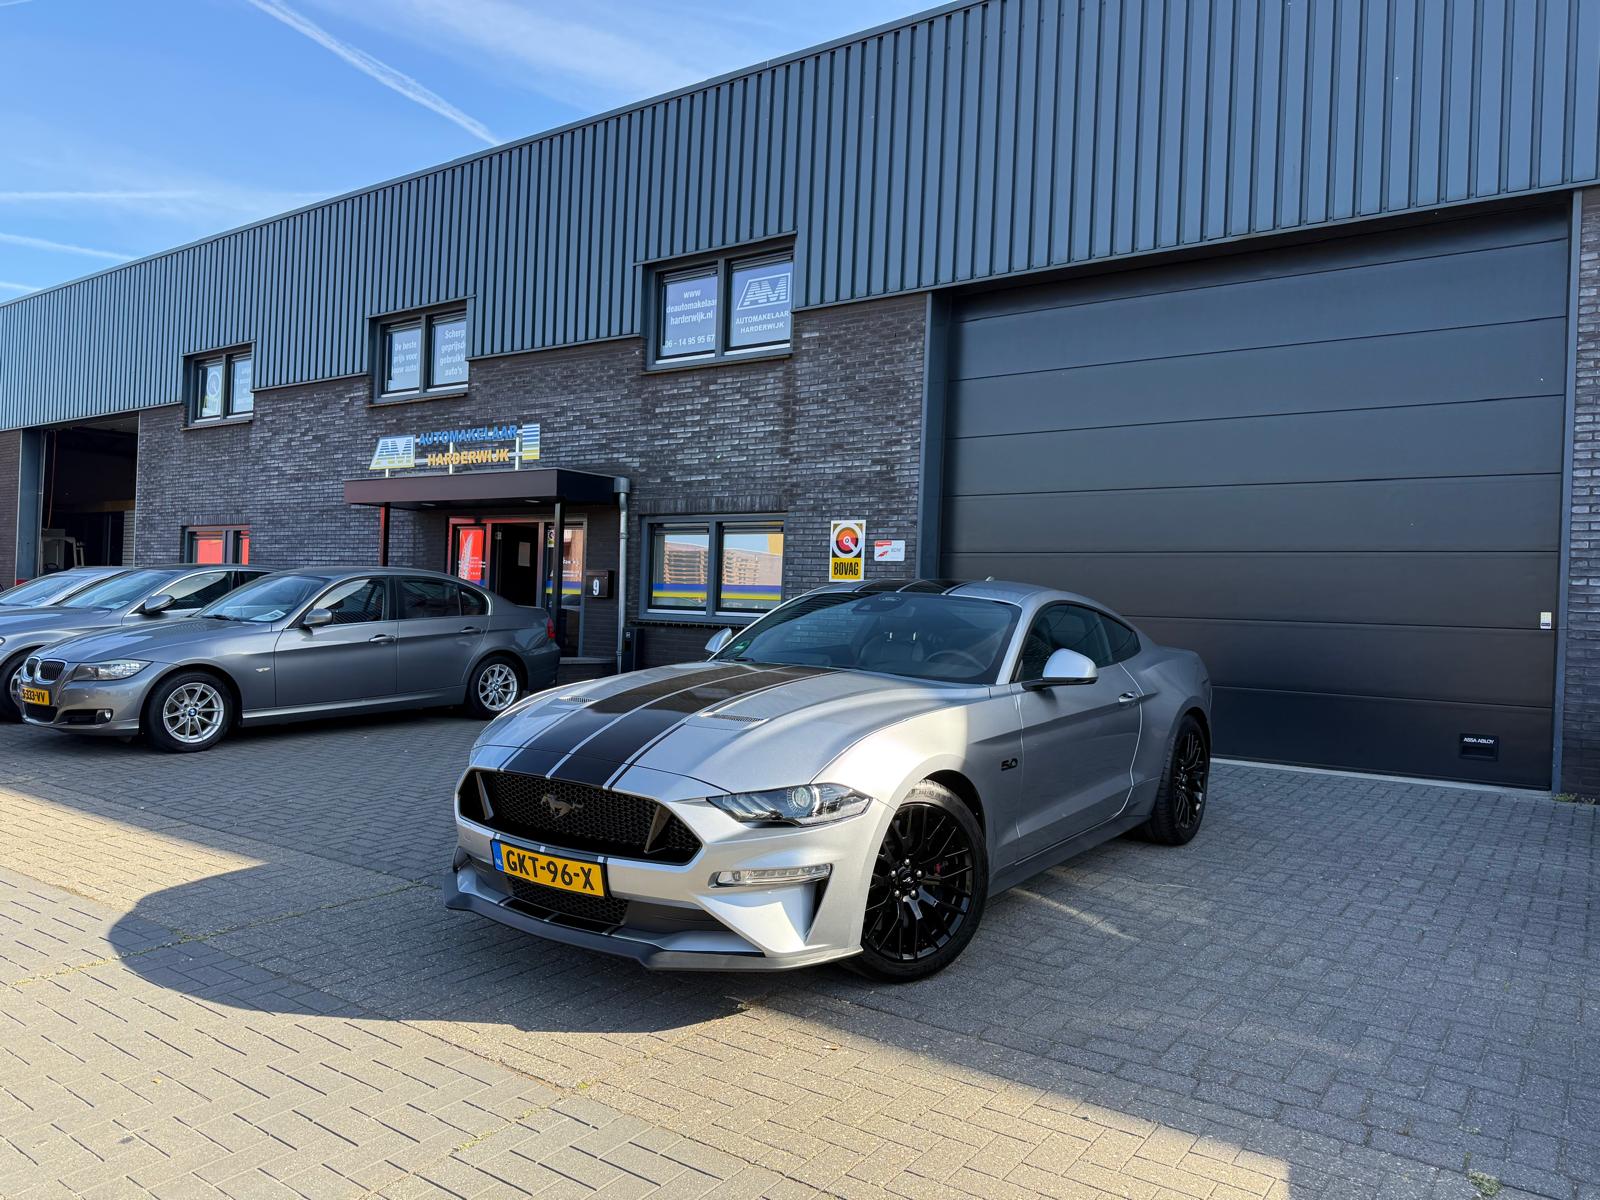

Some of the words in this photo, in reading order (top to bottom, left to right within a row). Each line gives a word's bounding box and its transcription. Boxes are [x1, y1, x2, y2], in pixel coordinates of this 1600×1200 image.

[670, 310, 713, 325] harderwijk.nl
[735, 311, 789, 325] AUTOMAKELAAR
[740, 321, 785, 334] HARDERWIJK
[418, 425, 518, 446] AUTOMAKELAAR
[427, 448, 509, 466] HARDERWIJK
[833, 561, 859, 576] BOVAG
[592, 578, 600, 596] 9
[506, 849, 595, 891] GKT-96-X
